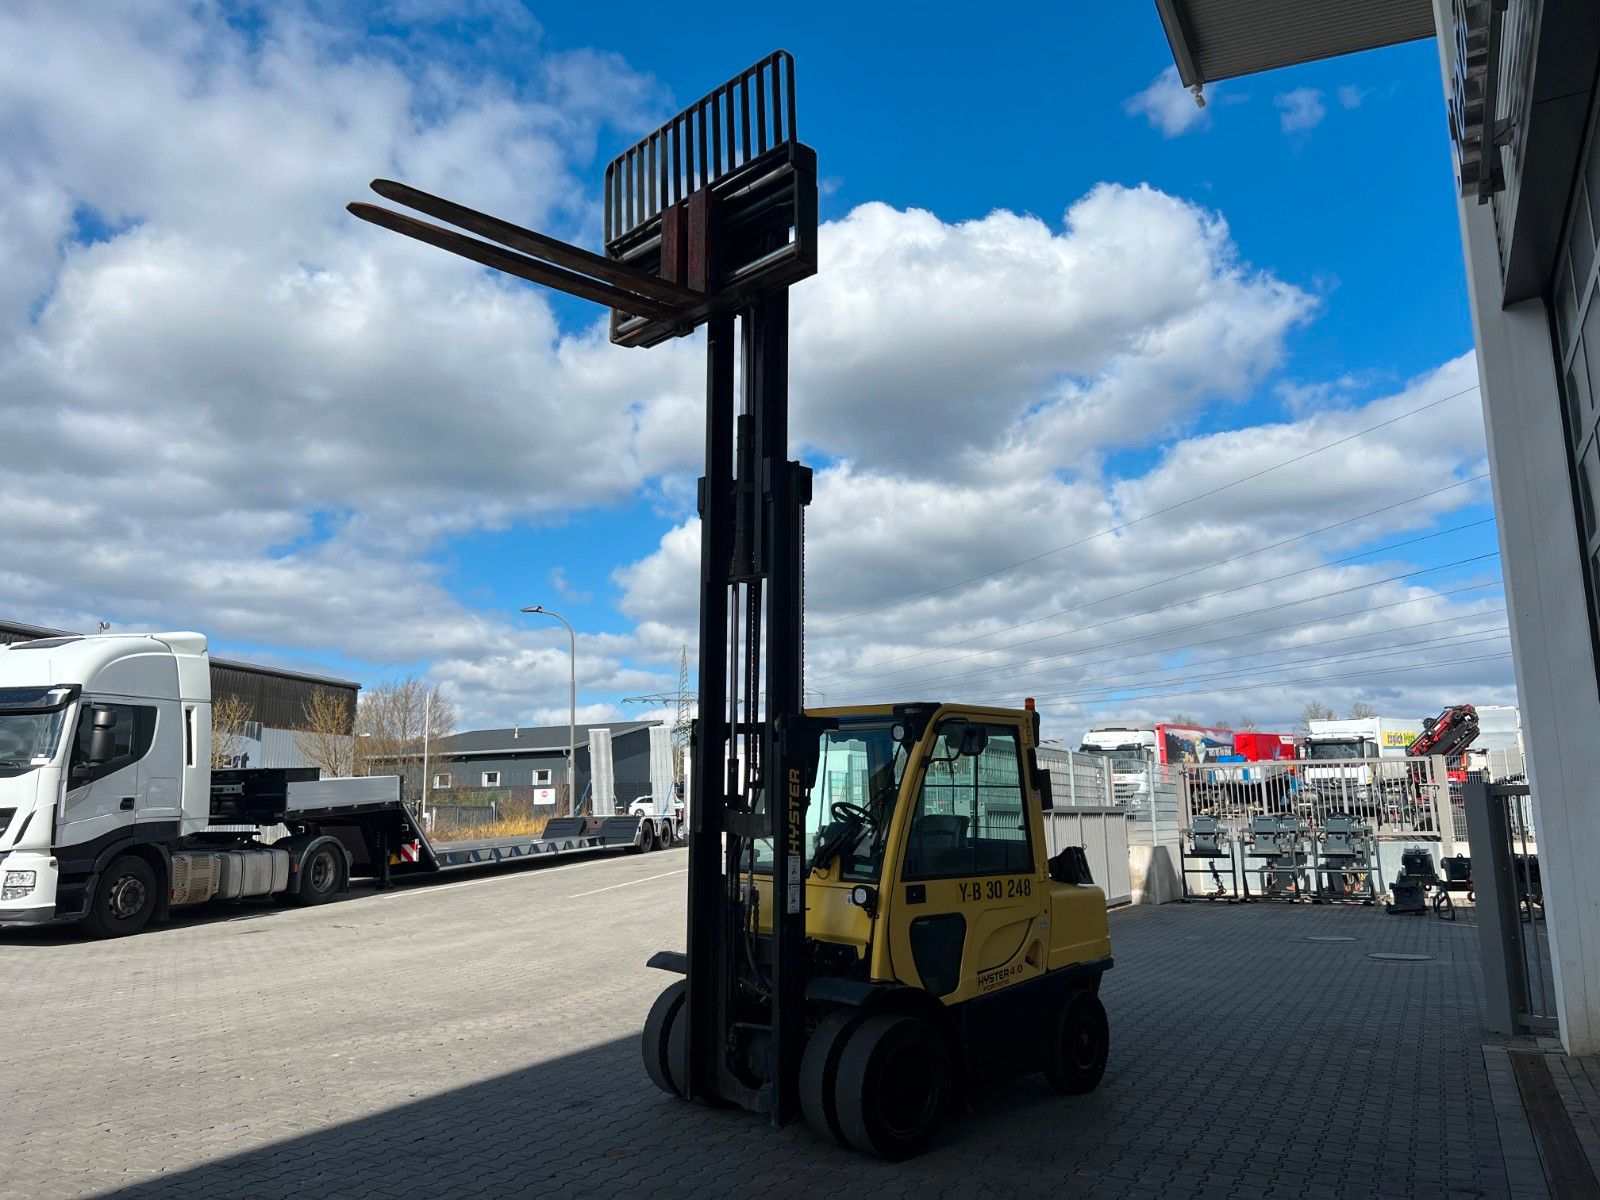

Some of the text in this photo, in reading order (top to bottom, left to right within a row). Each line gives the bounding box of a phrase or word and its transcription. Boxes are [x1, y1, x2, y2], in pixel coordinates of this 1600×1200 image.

[788, 768, 800, 856] HYSTER
[958, 878, 1032, 902] Y-B 30 248
[977, 968, 1010, 987] HYSTER
